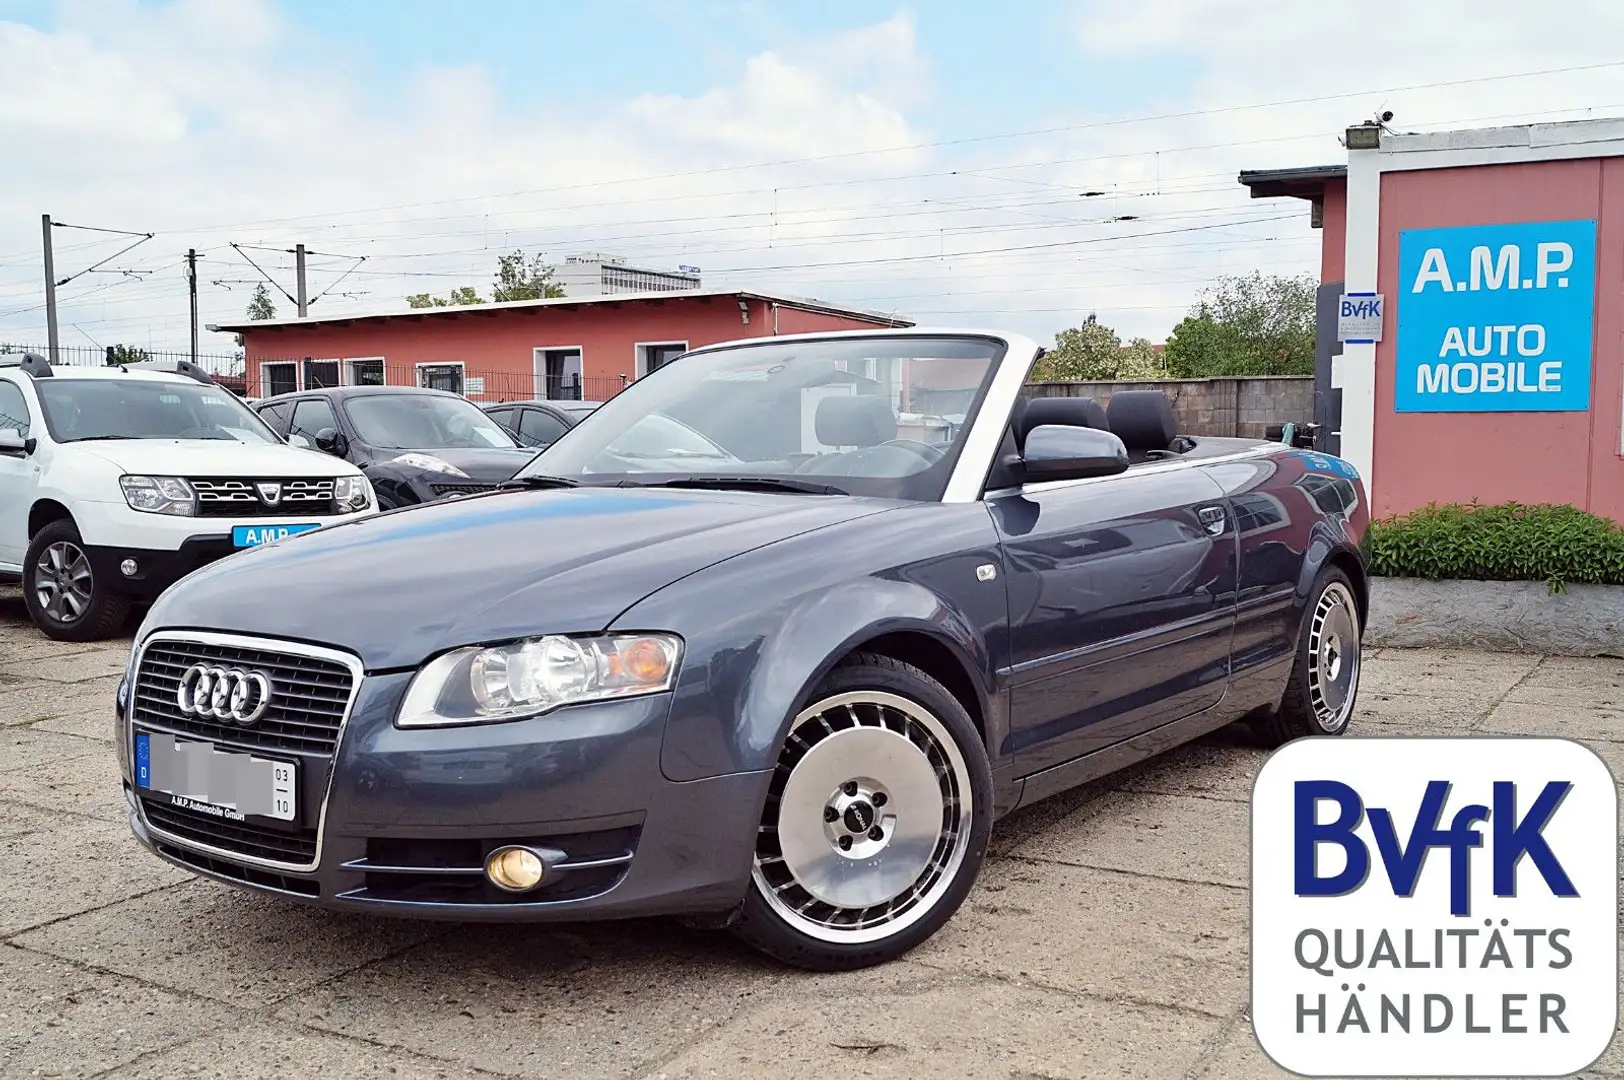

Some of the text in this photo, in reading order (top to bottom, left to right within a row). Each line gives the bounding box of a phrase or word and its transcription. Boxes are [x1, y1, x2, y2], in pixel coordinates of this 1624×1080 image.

[1411, 242, 1574, 294] A.M.P.
[1341, 300, 1381, 320] BvfK
[1439, 323, 1546, 358] AUTO
[1416, 361, 1563, 394] MOBILE
[275, 768, 288, 782] 03
[171, 795, 188, 808] A.M.P.
[189, 800, 223, 816] Automobile
[276, 799, 289, 813] 10
